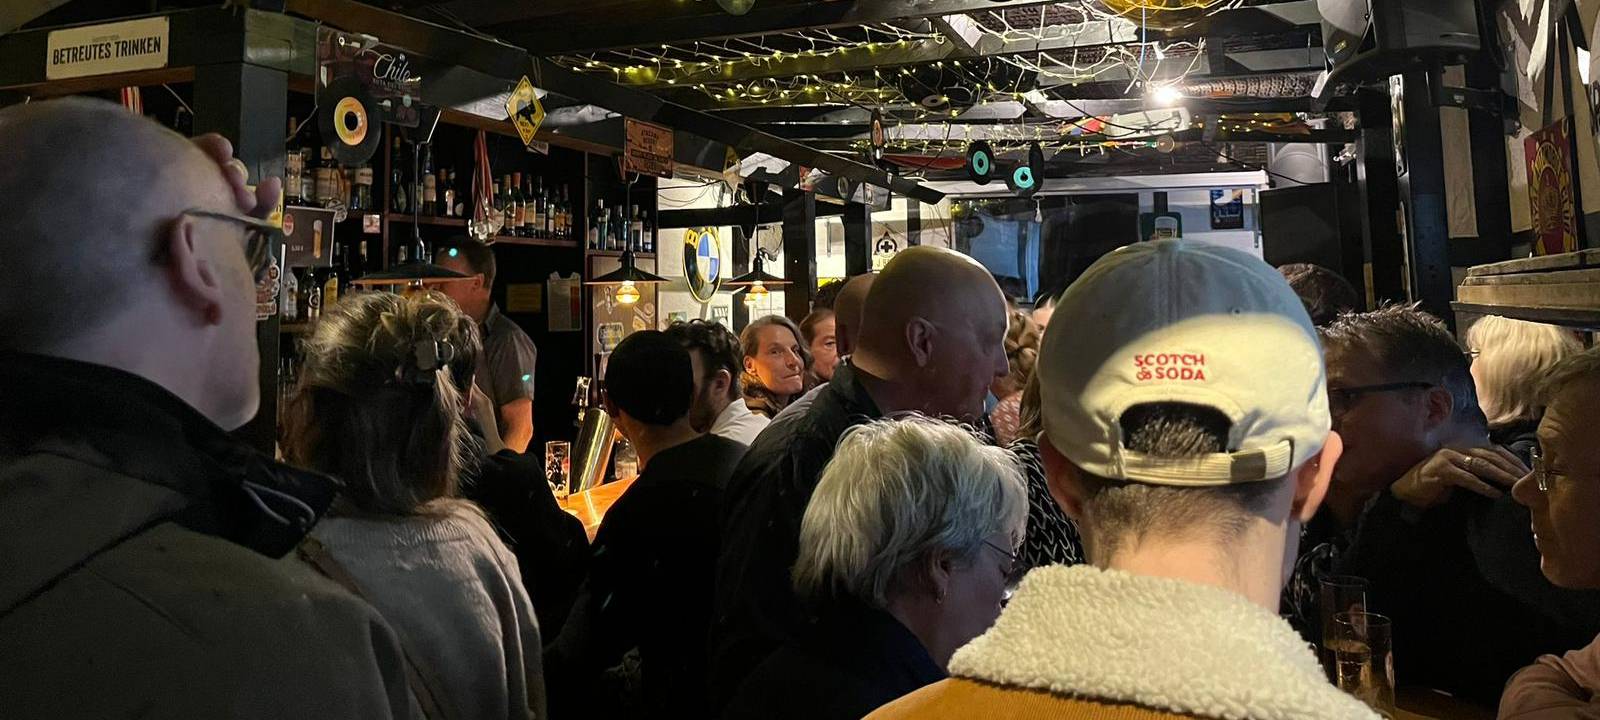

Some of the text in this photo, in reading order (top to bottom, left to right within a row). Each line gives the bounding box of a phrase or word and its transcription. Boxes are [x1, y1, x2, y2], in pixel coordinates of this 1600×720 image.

[53, 36, 161, 65] BETREUTES TRINKEN
[372, 51, 413, 82] Chile
[1134, 353, 1205, 367] SCOTCH
[1136, 367, 1205, 381] & SODA
